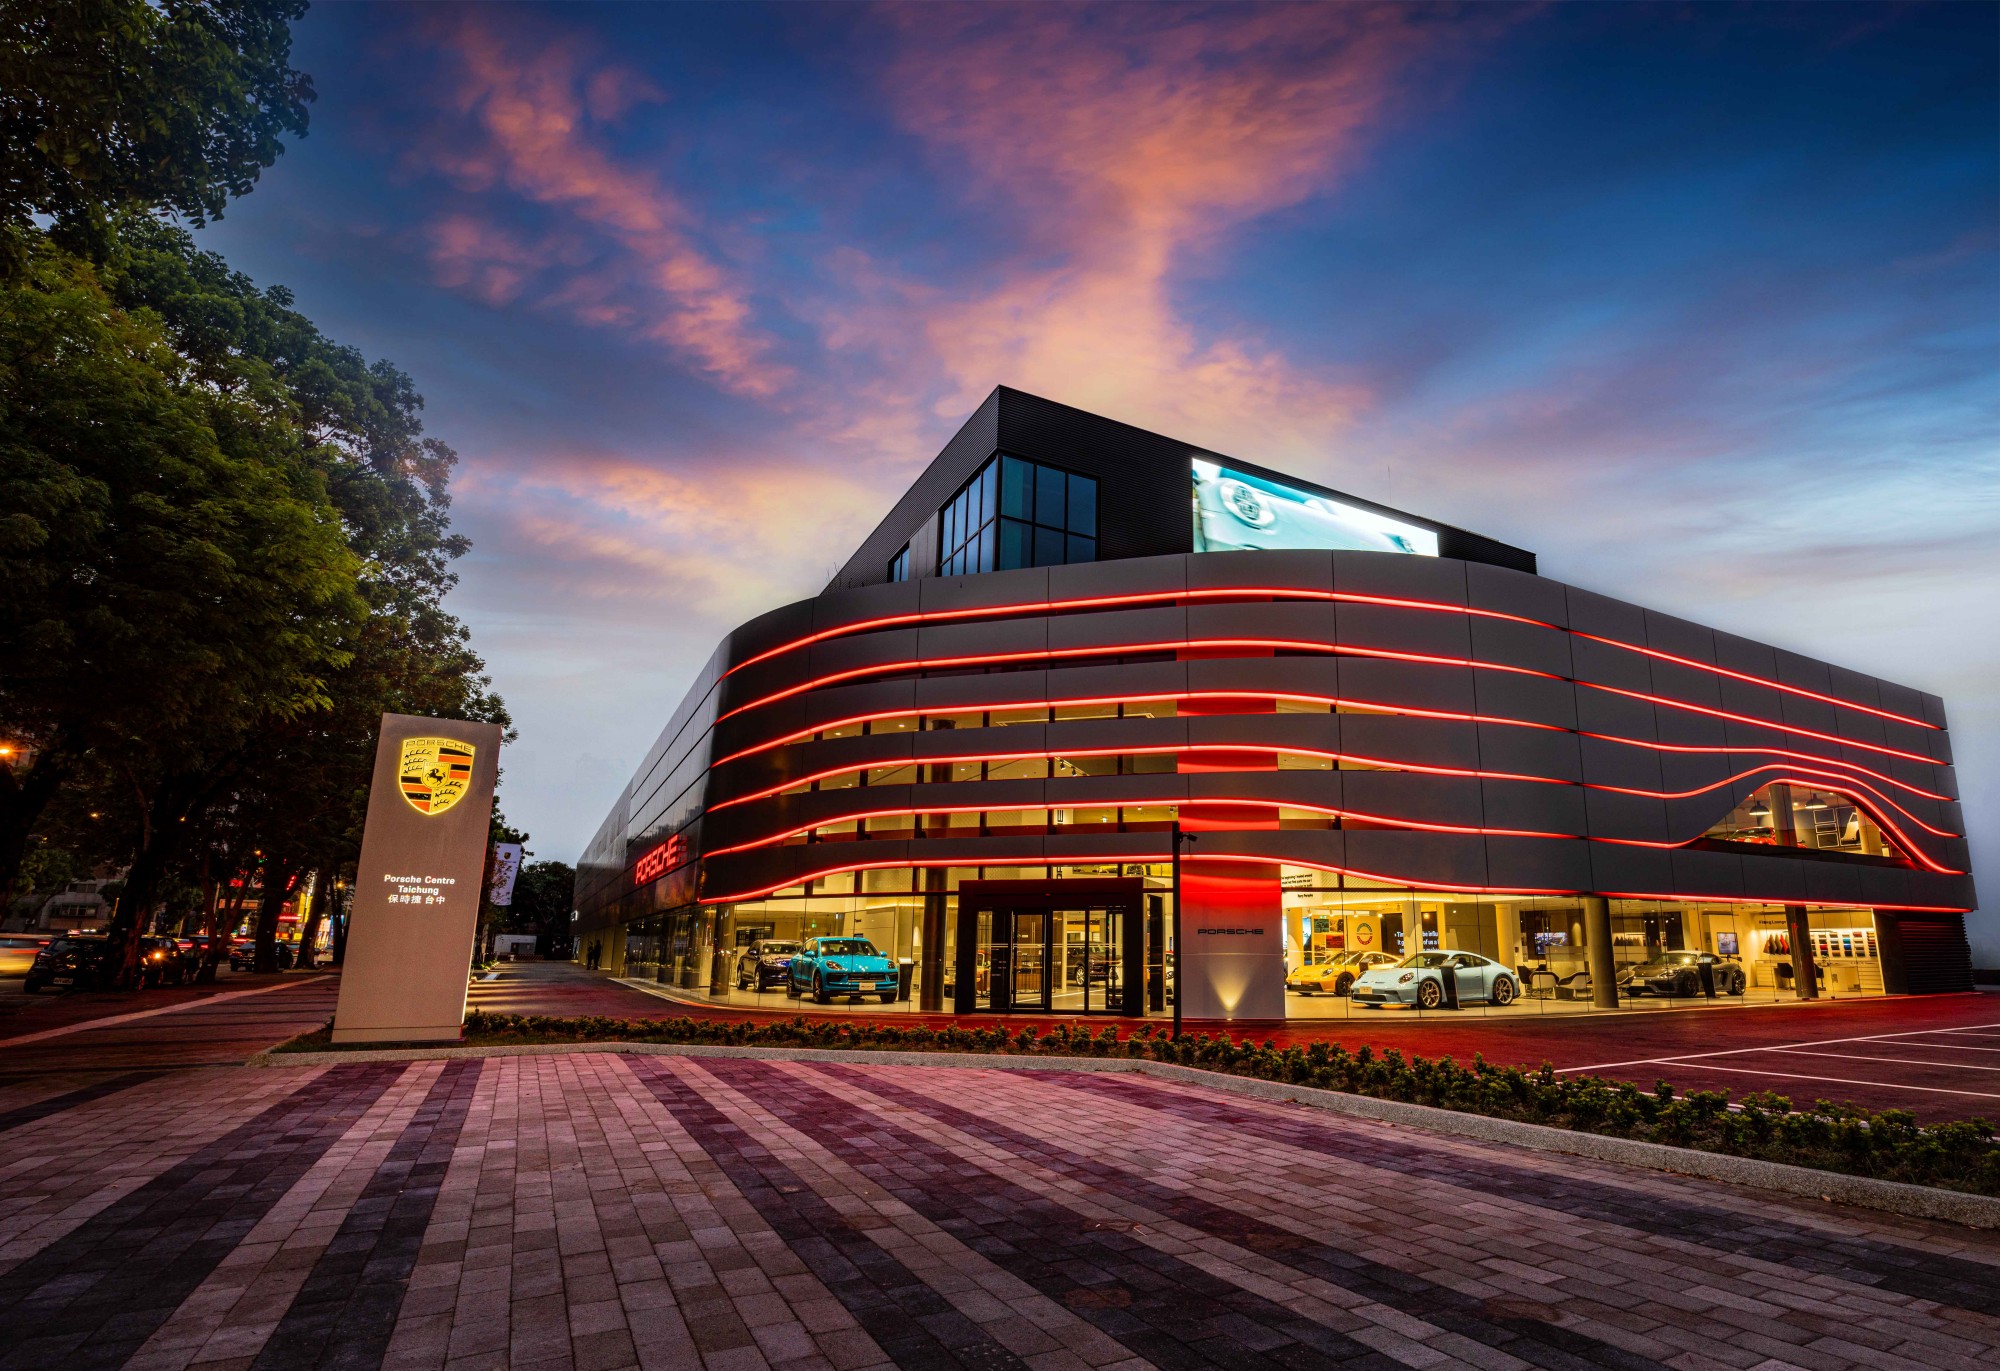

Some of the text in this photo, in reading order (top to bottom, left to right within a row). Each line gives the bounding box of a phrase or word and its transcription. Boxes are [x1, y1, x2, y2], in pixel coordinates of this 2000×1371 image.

[405, 739, 472, 754] PORSCHE
[634, 834, 681, 886] PORSCHE
[384, 874, 456, 885] Porsche Centre
[398, 884, 439, 896] Taichung
[425, 895, 446, 905] 台中
